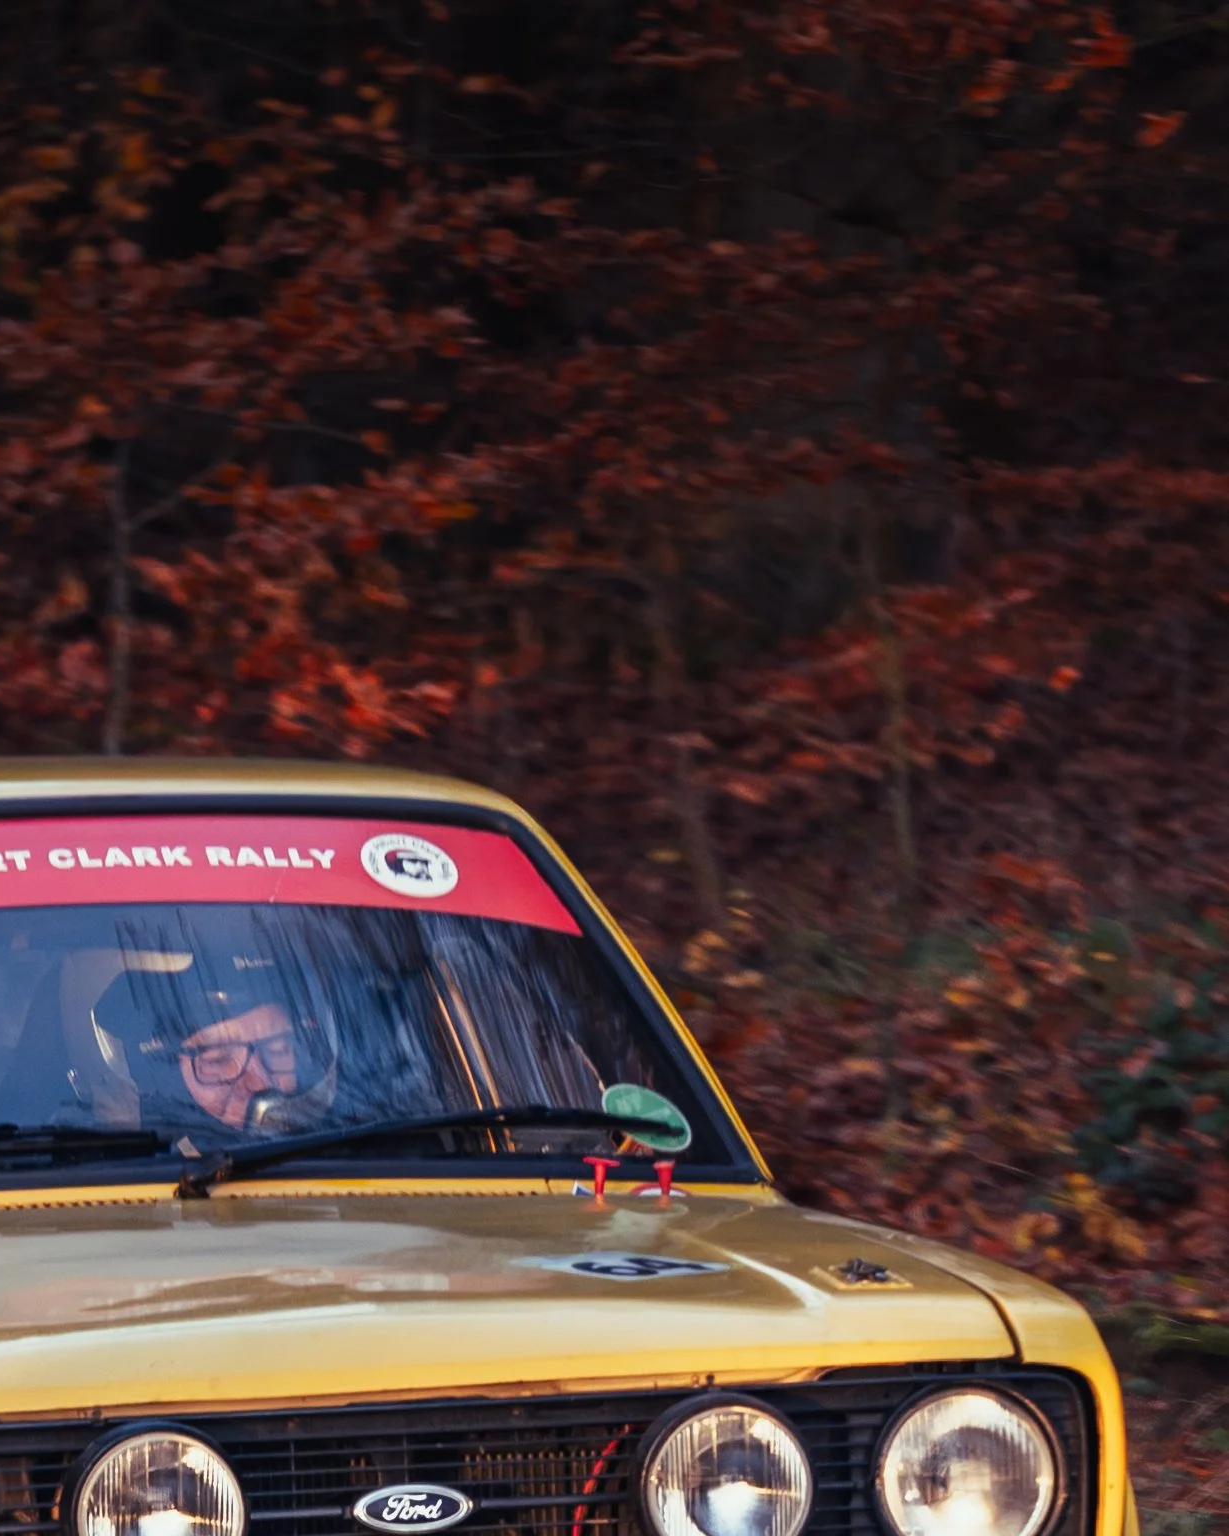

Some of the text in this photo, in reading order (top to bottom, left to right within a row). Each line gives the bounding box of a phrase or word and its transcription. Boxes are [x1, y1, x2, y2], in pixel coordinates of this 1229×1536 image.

[47, 846, 193, 870] CLARK
[204, 845, 336, 870] RALLY
[572, 1257, 717, 1276] 64
[382, 1493, 443, 1521] Ford
